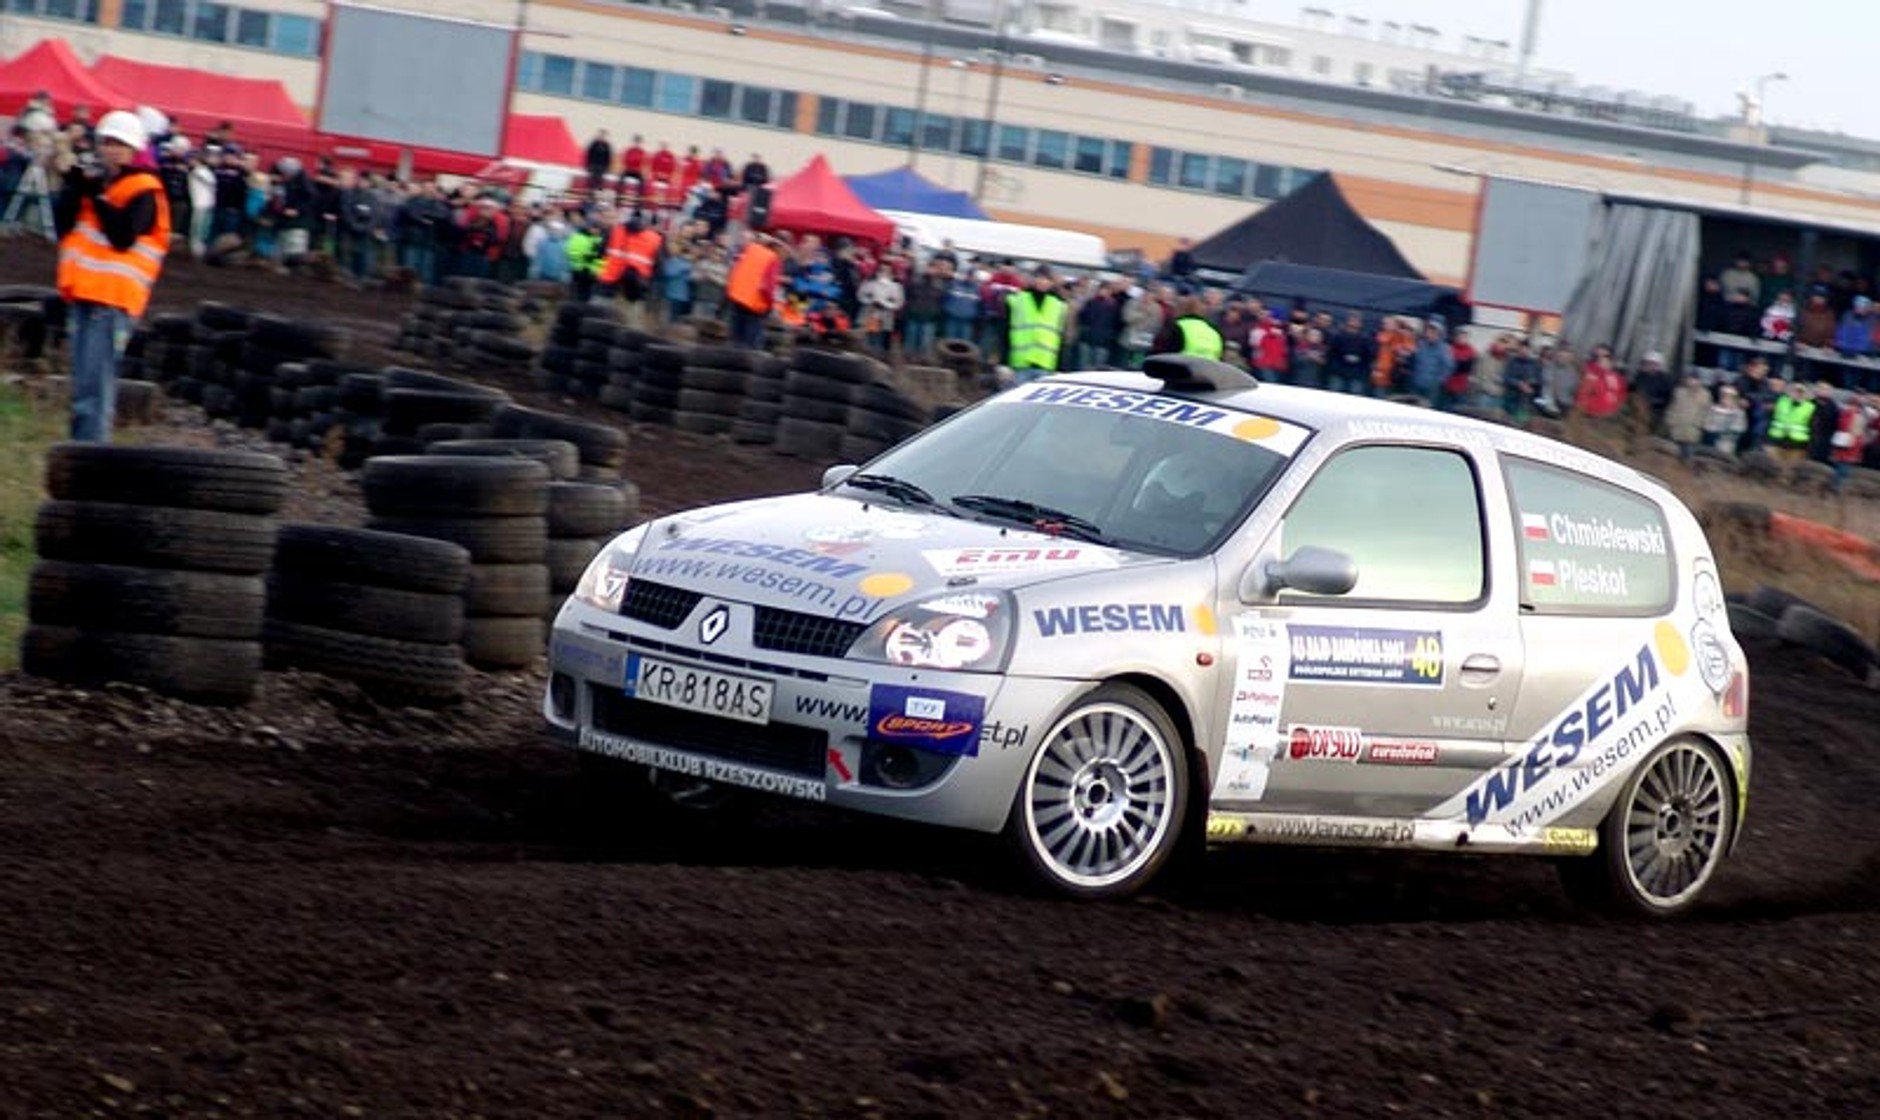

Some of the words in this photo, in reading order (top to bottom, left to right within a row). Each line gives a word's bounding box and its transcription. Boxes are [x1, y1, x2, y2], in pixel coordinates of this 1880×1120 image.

[1023, 386, 1227, 426] WESEM
[1551, 512, 1666, 555] Chmielewski
[658, 537, 870, 578] WESEM
[633, 557, 885, 620] www.wesem.pl
[1034, 603, 1187, 638] WESEM
[642, 662, 677, 700] KR
[679, 673, 767, 718] 818AS
[1465, 643, 1660, 828] WESEM
[705, 760, 827, 801] RZESZOWSKI
[1503, 692, 1677, 838] www.wesem.pl
